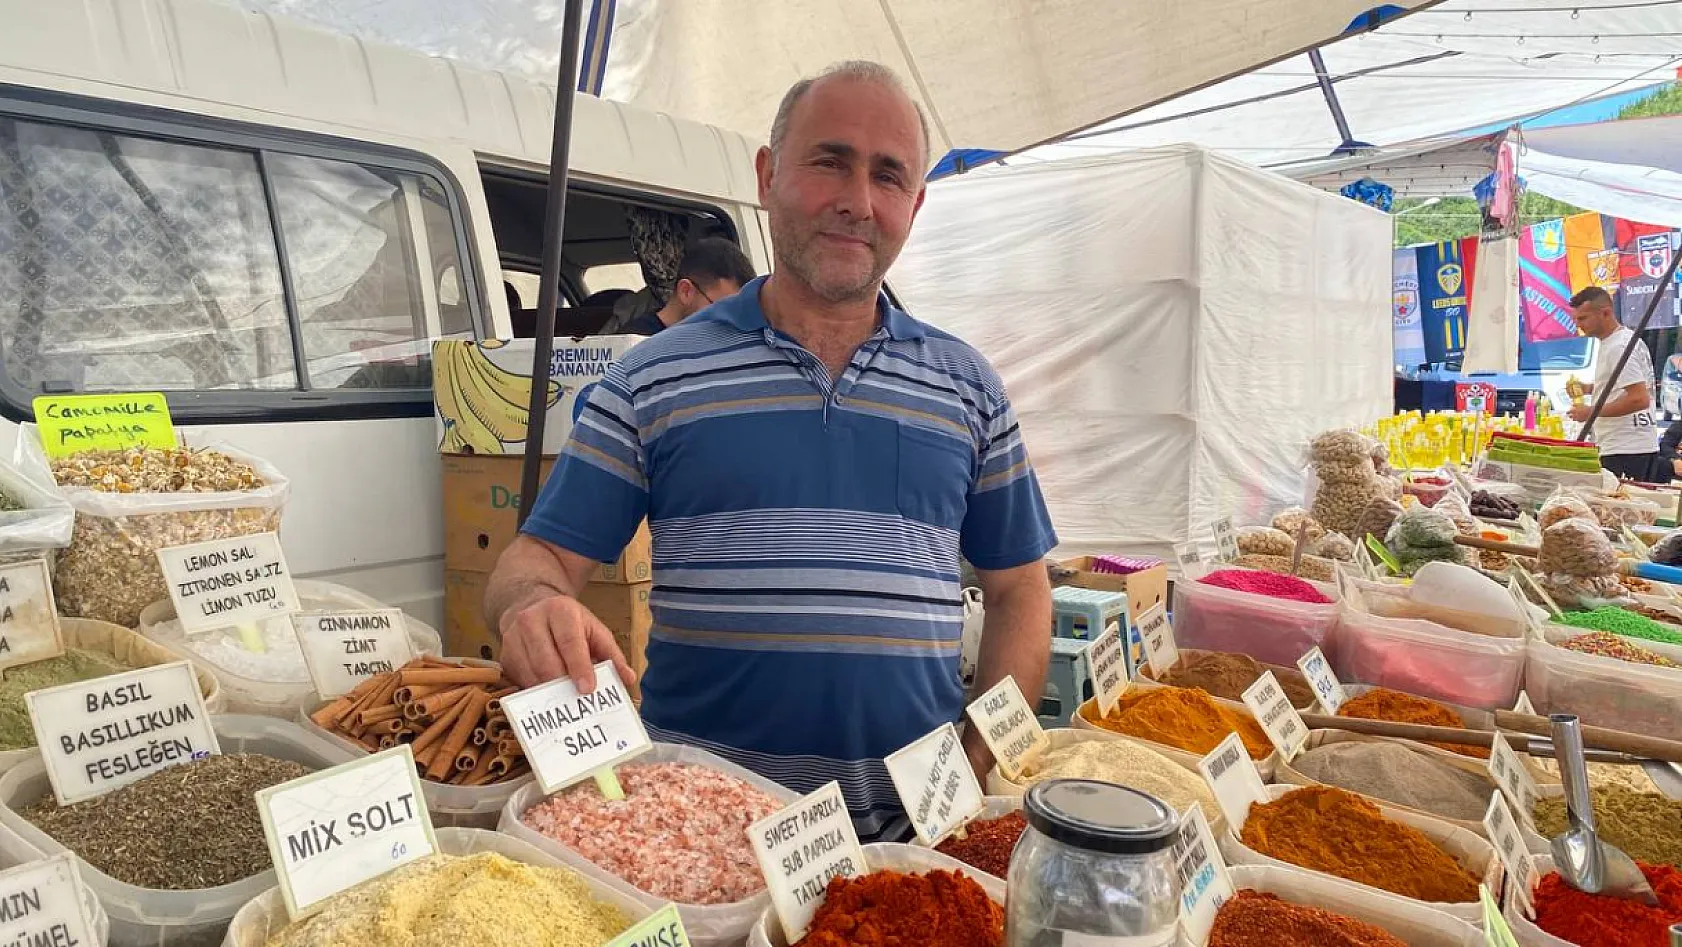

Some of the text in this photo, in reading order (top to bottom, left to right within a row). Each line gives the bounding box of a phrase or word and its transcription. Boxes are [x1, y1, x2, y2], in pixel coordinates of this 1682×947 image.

[1522, 286, 1556, 315] ASTON
[184, 551, 228, 572] LEMON
[178, 571, 243, 597] ZITRONEN
[244, 586, 276, 604] TUZU
[318, 616, 391, 632] CINNAMON
[85, 682, 152, 712] BASIL
[60, 703, 194, 755] BASILLIKUM
[563, 723, 610, 756] SALT
[85, 736, 193, 784] FESLEĞEN
[928, 761, 942, 788] HOT
[347, 793, 414, 838] SOLT
[764, 795, 842, 850] SWEET PAPRIKA
[391, 841, 407, 860] 60
[803, 828, 845, 863] PAPRIKA
[793, 875, 826, 905] TATLI
